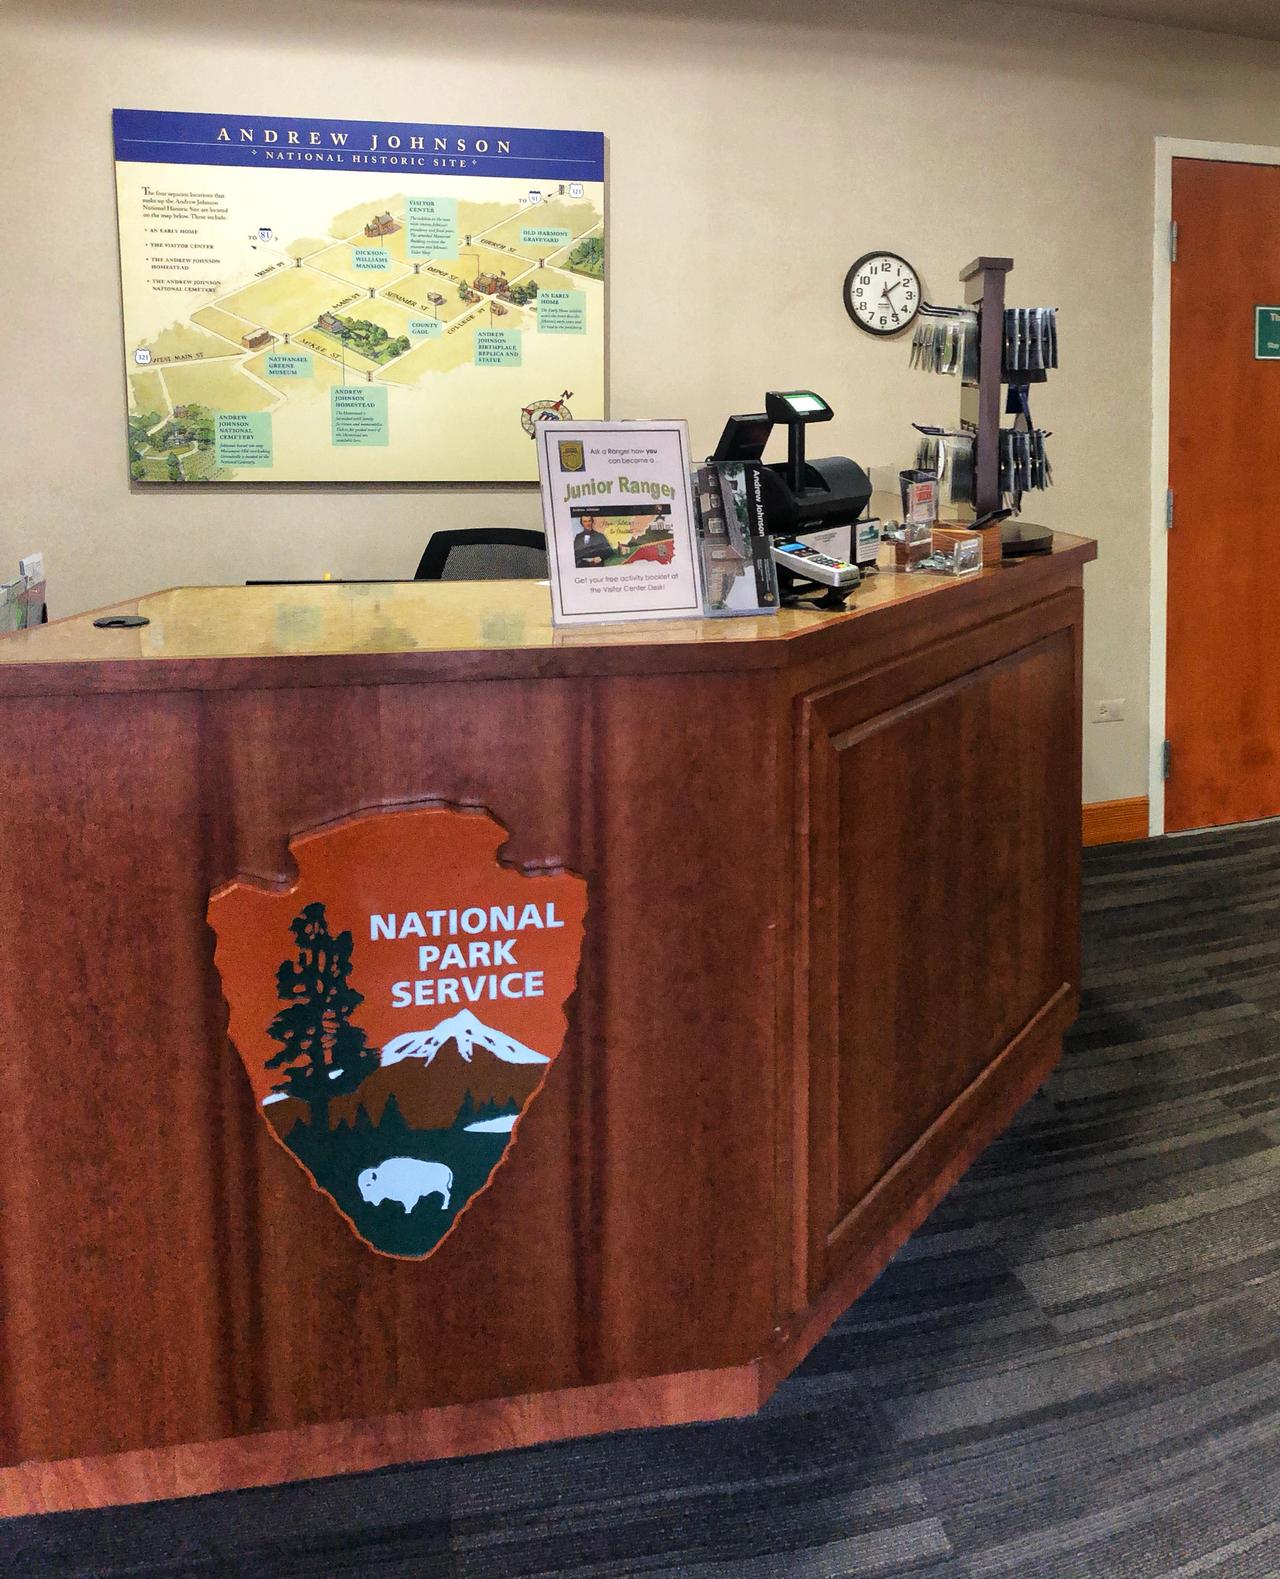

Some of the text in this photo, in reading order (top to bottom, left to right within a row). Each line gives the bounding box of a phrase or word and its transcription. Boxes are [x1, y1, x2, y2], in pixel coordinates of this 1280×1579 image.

[217, 128, 511, 153] ANDREW JOHNSON
[265, 151, 467, 168] NATIONAL HISTORIC SITE
[141, 186, 154, 196] The
[870, 266, 877, 274] 11
[881, 263, 891, 272] 12
[897, 268, 900, 276] 1
[426, 267, 449, 278] DEPOT
[860, 276, 870, 285] 10
[903, 279, 910, 287] 2
[856, 288, 863, 297] 9
[905, 291, 913, 300] 3
[332, 296, 351, 309] MAIN
[385, 291, 417, 306] SUMMER
[859, 302, 867, 310] 8
[901, 305, 908, 313] 4
[869, 312, 875, 320] 7
[880, 316, 887, 325] 6
[891, 313, 899, 322] 5
[448, 315, 475, 335] COLLEGE
[561, 390, 574, 399] N
[564, 476, 675, 502] Junior Ranger
[752, 470, 765, 537] Andrew Johnson
[369, 902, 566, 942] NATIONAL
[418, 938, 519, 972] PARK
[390, 970, 546, 1009] SERVICE
